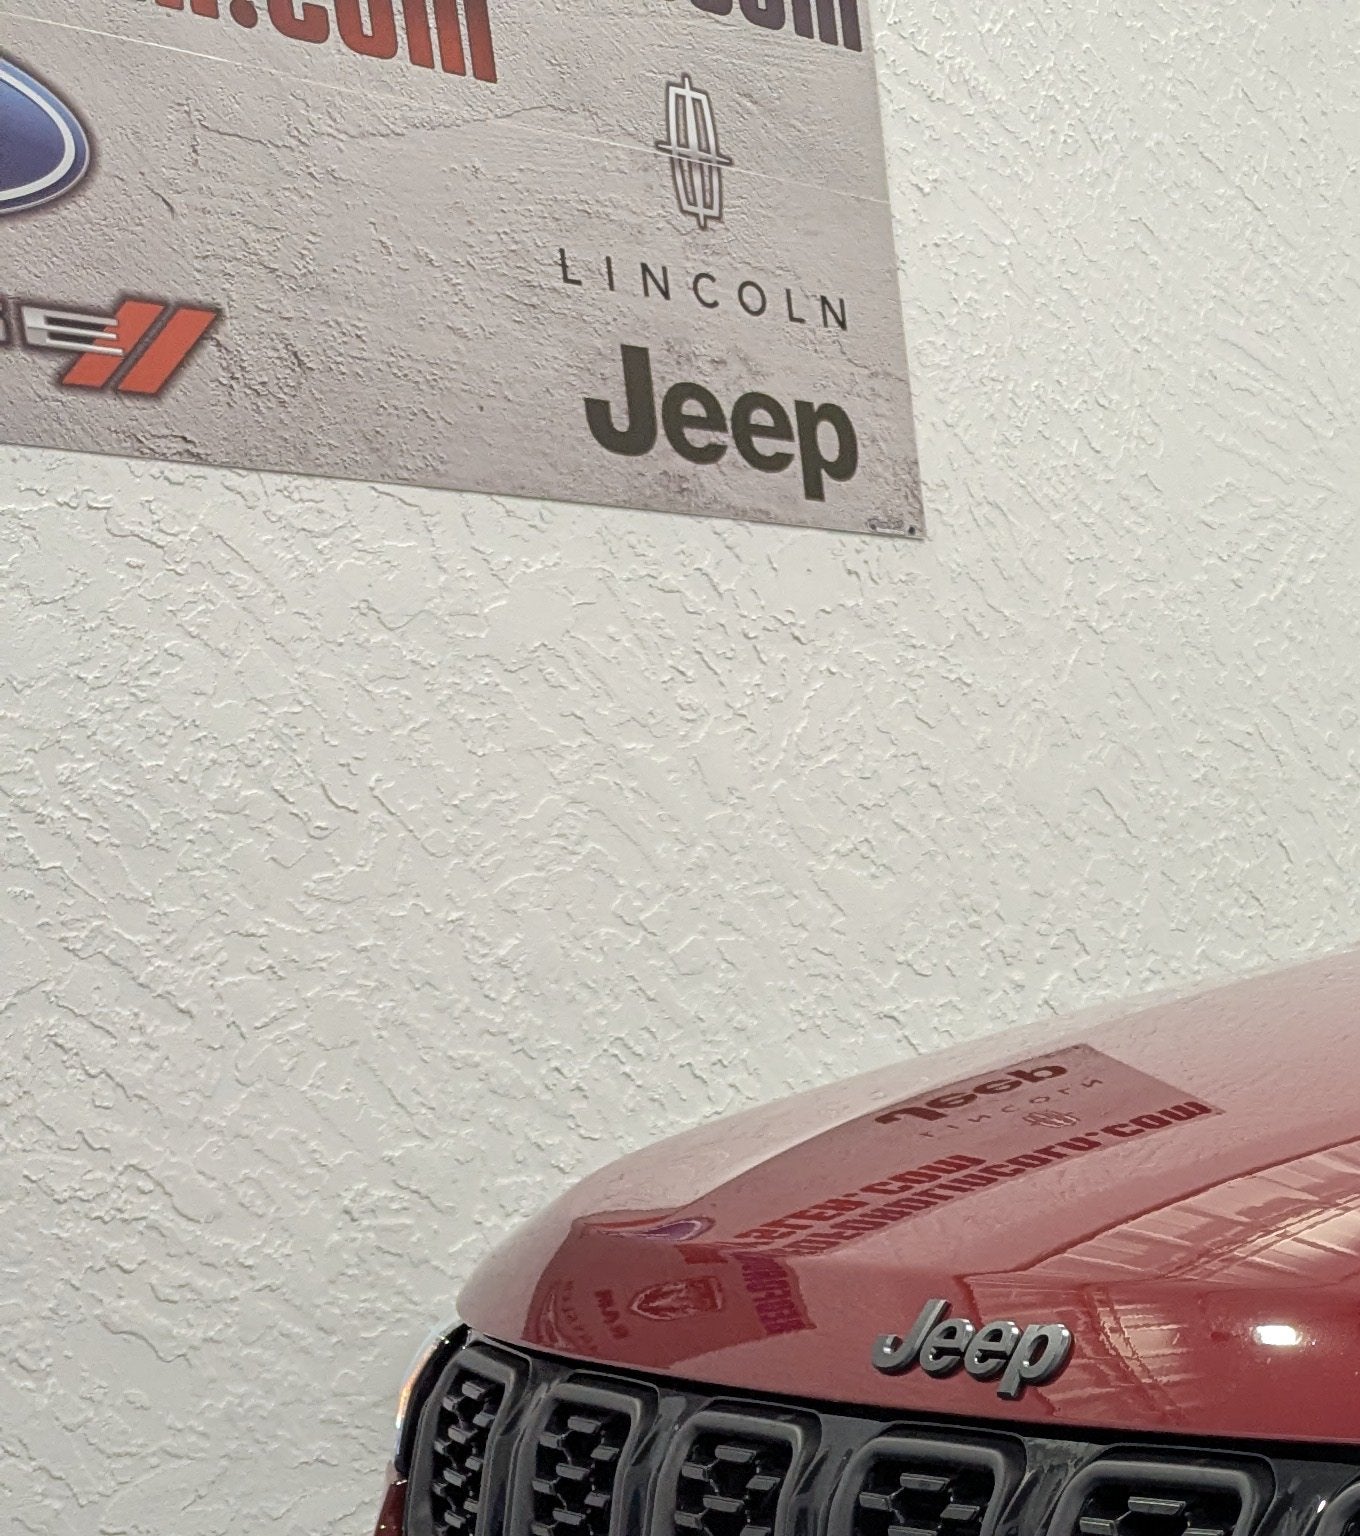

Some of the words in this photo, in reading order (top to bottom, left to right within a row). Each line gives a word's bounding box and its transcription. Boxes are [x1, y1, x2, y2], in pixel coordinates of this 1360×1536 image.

[559, 247, 848, 331] LINCOLN
[583, 344, 859, 501] Jeep
[872, 1298, 1075, 1401] Jeep
